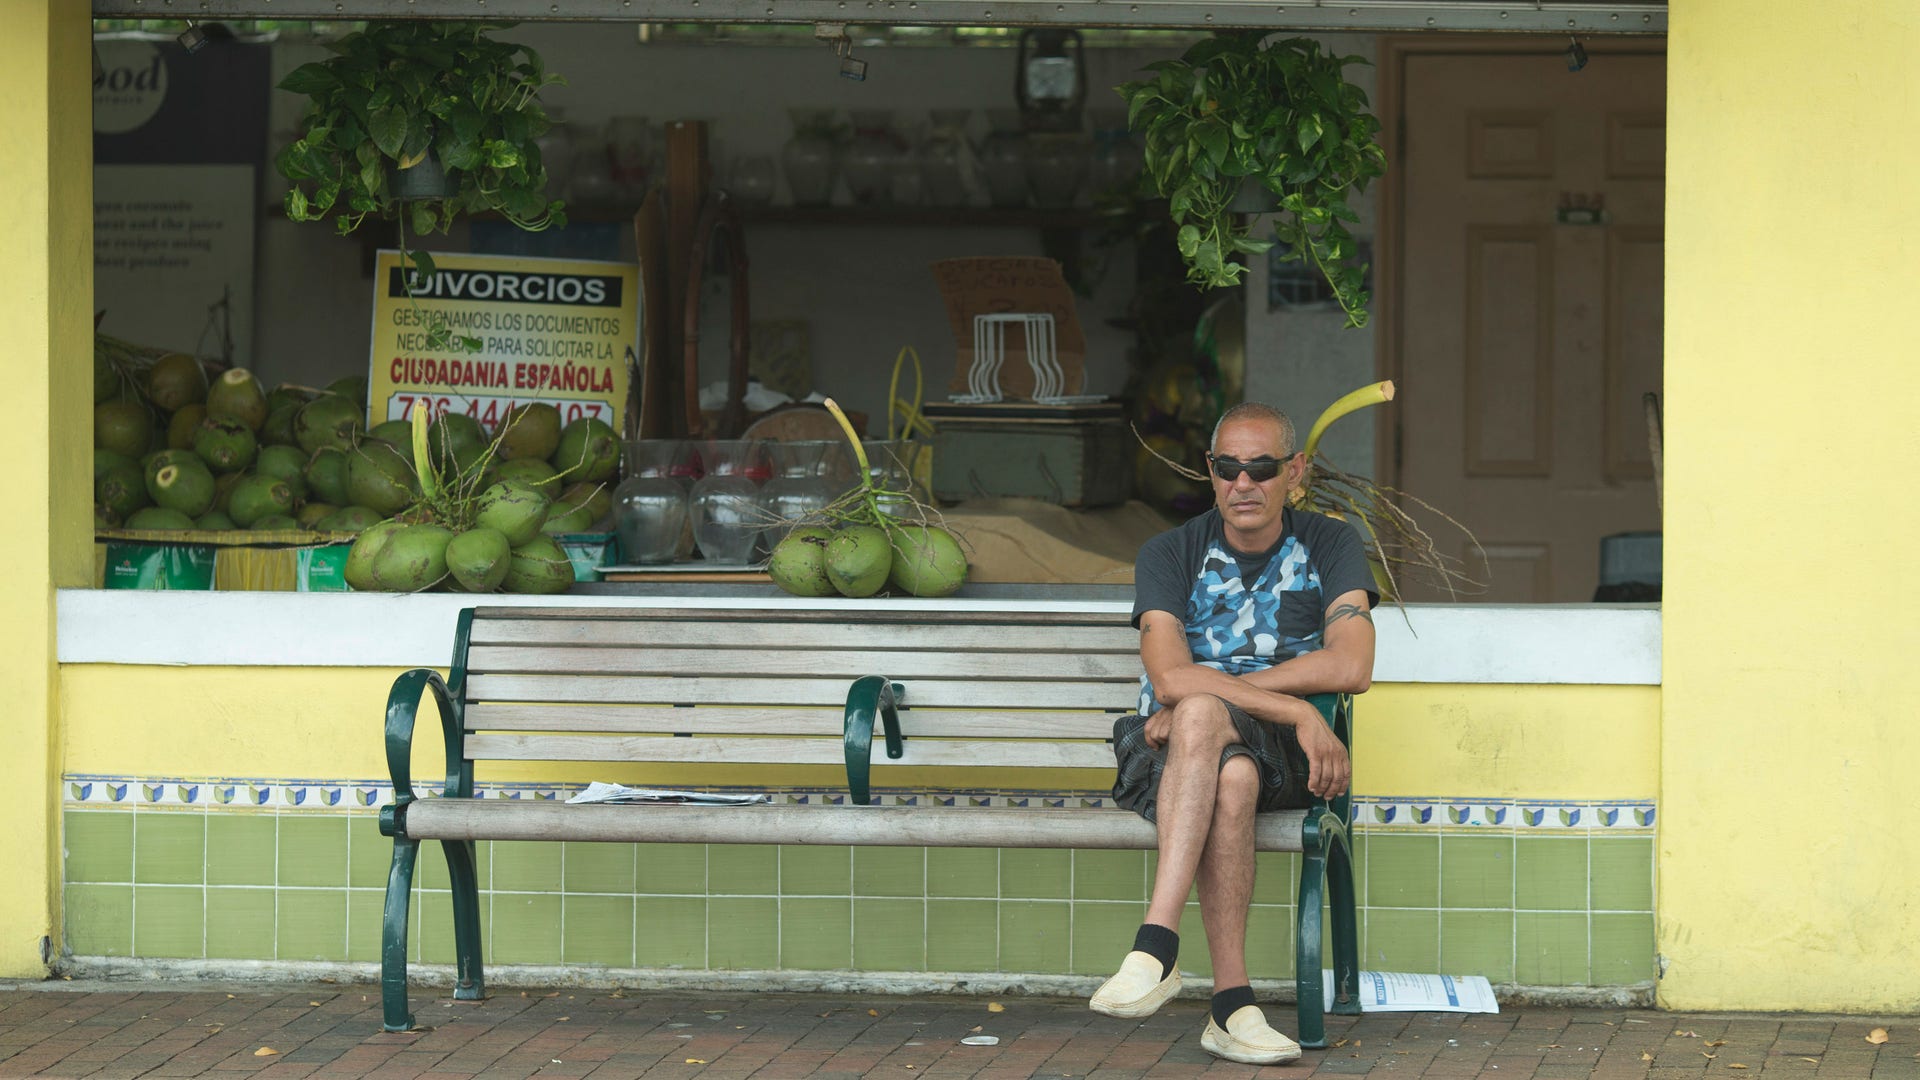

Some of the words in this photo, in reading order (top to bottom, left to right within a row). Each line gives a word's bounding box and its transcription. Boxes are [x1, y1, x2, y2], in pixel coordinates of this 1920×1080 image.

[409, 271, 606, 303] DIVORCIOS
[392, 308, 492, 330] GESTIONAMOS
[495, 313, 522, 331] LOS
[525, 314, 620, 336] DOCUMENTOS
[397, 333, 484, 353] NECARS
[488, 337, 523, 356] PARA
[525, 338, 594, 359] SOLICITAR
[597, 342, 613, 360] LA
[390, 357, 509, 389] CIUDADANIA
[515, 360, 614, 393] ESPAÑOLA
[554, 402, 602, 425] 07
